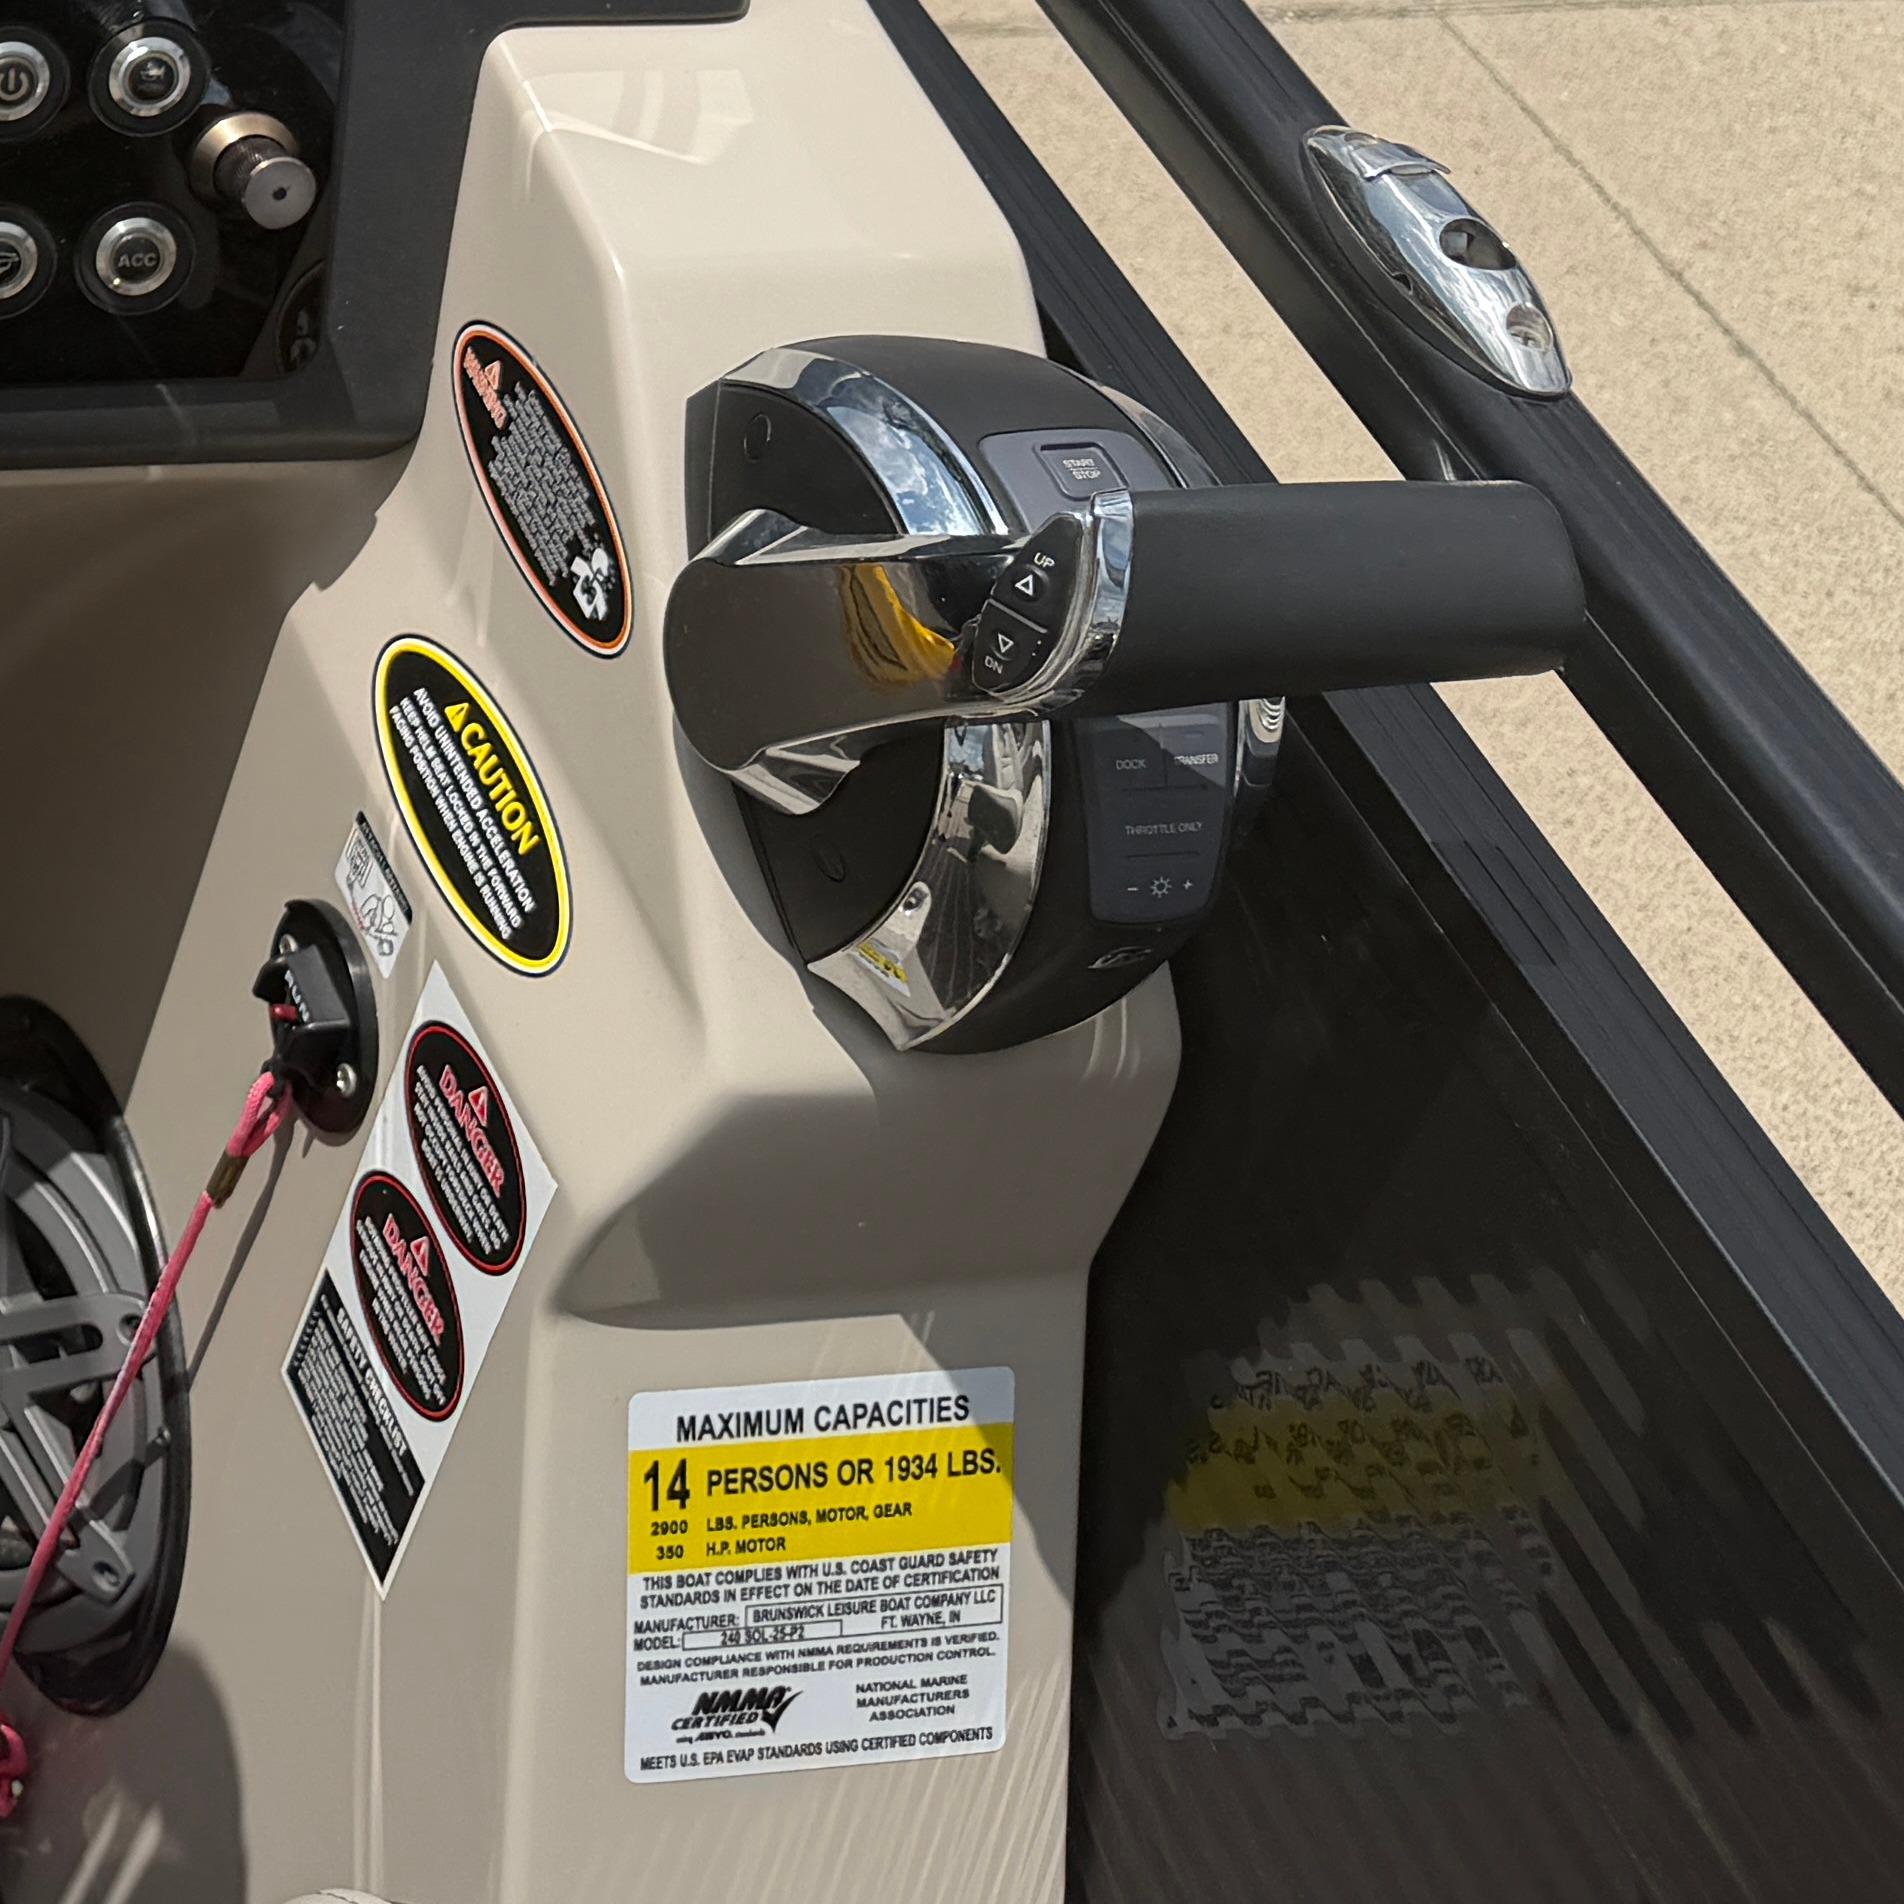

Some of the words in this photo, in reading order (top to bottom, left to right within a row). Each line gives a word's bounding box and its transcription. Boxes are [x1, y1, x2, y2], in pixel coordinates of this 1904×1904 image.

[117, 253, 158, 268] ACC
[1063, 458, 1096, 468] START
[1072, 469, 1102, 480] STOP
[1034, 552, 1056, 568] UP
[984, 656, 1004, 674] DN
[1116, 759, 1146, 770] DOCK
[414, 688, 440, 727] AVOID
[435, 726, 482, 808] UNINTENDED
[477, 809, 533, 910] ACCELERATION
[461, 723, 537, 852] CAUTION
[415, 726, 436, 758] HELM
[445, 785, 473, 832] LOCKED
[476, 844, 492, 869] THE
[488, 868, 520, 927] FORWARD
[435, 794, 457, 831] WHEN
[452, 829, 478, 873] ENGINE
[1124, 824, 1176, 836] THROTTLE
[1177, 822, 1203, 834] ONLY
[440, 1066, 503, 1195] DANGER
[383, 1215, 443, 1342] DANGER
[337, 1308, 366, 1367] SAFETY
[365, 1369, 405, 1454] CHECKLIST
[676, 1408, 804, 1442] MAXIMUM
[813, 1395, 970, 1432] CAPACITIES
[643, 1457, 690, 1512] 14
[707, 1461, 828, 1496] PERSONS
[836, 1458, 874, 1486] OR
[886, 1453, 937, 1481] 1934
[947, 1447, 1001, 1476] LBS.
[650, 1519, 687, 1535] 2900
[706, 1516, 736, 1531] LBS.
[741, 1510, 811, 1529] PERSONS,
[815, 1505, 869, 1524] MOTOR,
[873, 1502, 912, 1518] GEAR
[656, 1544, 683, 1560] 350
[706, 1541, 730, 1556] H.P.
[735, 1537, 786, 1553] MOTOR
[643, 1575, 673, 1591] THIS
[676, 1572, 711, 1588] BOAT
[714, 1567, 782, 1585] COMPLIES
[786, 1564, 818, 1579] WITH
[822, 1561, 846, 1576] U.S.
[850, 1557, 895, 1574] COAST
[898, 1553, 945, 1570] GUARD
[948, 1549, 997, 1566] SAFETY
[640, 1589, 719, 1608] STANDARDS
[723, 1588, 736, 1602] IN
[740, 1584, 791, 1601] EFFECT
[794, 1582, 813, 1596] ON
[816, 1580, 842, 1594] THE
[845, 1576, 879, 1592] DATE
[882, 1575, 899, 1589] OF
[902, 1566, 999, 1587] CERTIFICATION
[633, 1613, 739, 1634] MANUFACTURER:
[752, 1604, 823, 1622] BRUNSWICK
[826, 1599, 876, 1616] LEISURE
[880, 1596, 911, 1611] BOAT
[913, 1591, 971, 1609] COMPANY
[974, 1589, 995, 1603] LLC
[880, 1615, 898, 1629] FT.
[901, 1611, 945, 1628] WAYNE,
[949, 1610, 960, 1623] IN
[633, 1635, 680, 1651] MODEL:
[636, 1658, 681, 1671] DESIGN
[684, 1651, 761, 1668] COMPLIANCE
[765, 1648, 793, 1661] WITH
[797, 1645, 833, 1658] NMMA
[836, 1637, 927, 1655] REQUIREMENTS
[945, 1631, 999, 1645] VERIFIED.
[640, 1667, 738, 1686] MANUFACTURER
[742, 1660, 825, 1677] RESPONSIBLE
[828, 1658, 853, 1670] FOR
[856, 1651, 933, 1668] PRODUCTION
[937, 1646, 995, 1660] CONTROL.
[692, 1685, 786, 1715] NMMA
[855, 1678, 915, 1693] NATIONAL
[920, 1674, 967, 1687] MARINE
[856, 1689, 969, 1708] MANUFACTURERS
[671, 1711, 758, 1730] CERTIFIED
[869, 1704, 955, 1721] ASSOCIATION
[640, 1755, 676, 1770] MEETS
[680, 1753, 700, 1766] U.S.
[703, 1751, 723, 1765] EPA
[727, 1748, 754, 1763] EVAP
[757, 1742, 822, 1760] STANDARDS
[825, 1739, 858, 1754] USING
[861, 1733, 916, 1750] CERTIFIED
[919, 1727, 992, 1745] COMPONENTS
